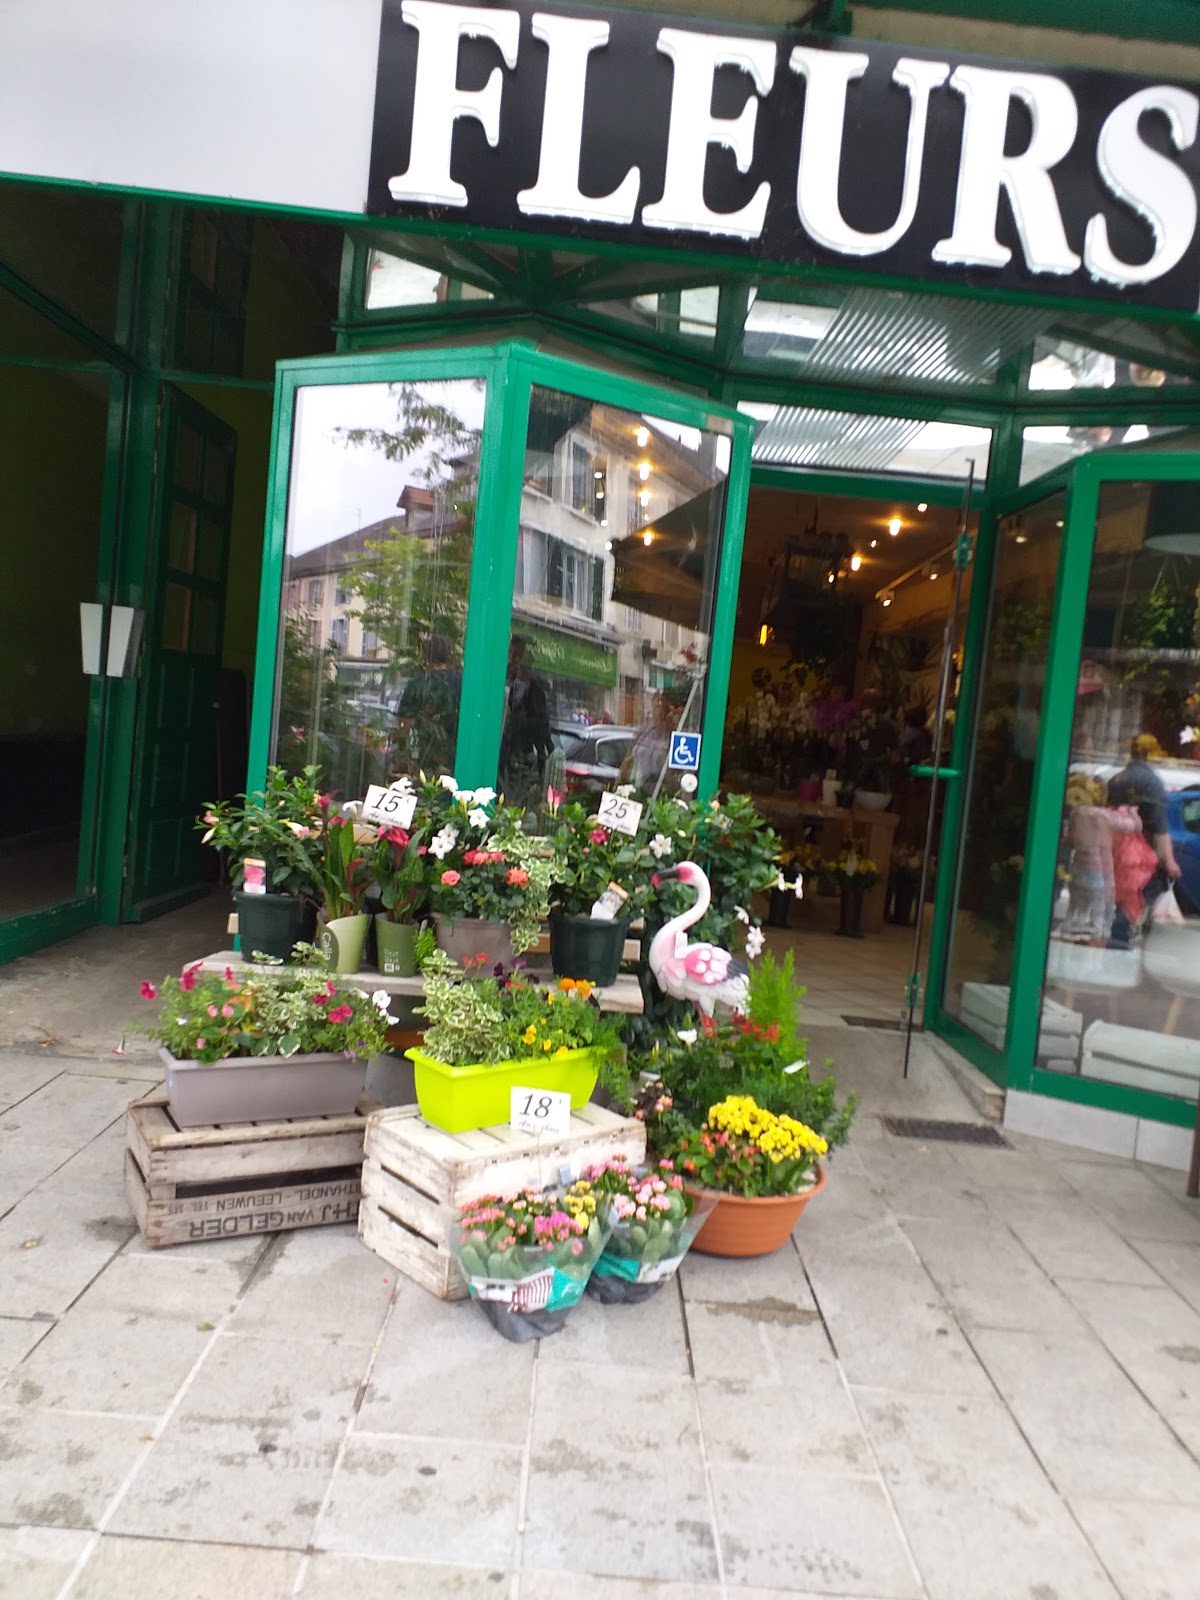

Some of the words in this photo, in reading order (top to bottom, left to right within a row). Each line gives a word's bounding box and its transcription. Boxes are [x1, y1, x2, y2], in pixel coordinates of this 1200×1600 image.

[387, 0, 1199, 288] FLEURS
[371, 792, 403, 813] 15
[603, 798, 631, 819] 25
[519, 1093, 553, 1119] 18
[217, 1192, 282, 1211] LEEUWEN
[190, 1211, 283, 1238] GELDER
[288, 1209, 314, 1223] VAN
